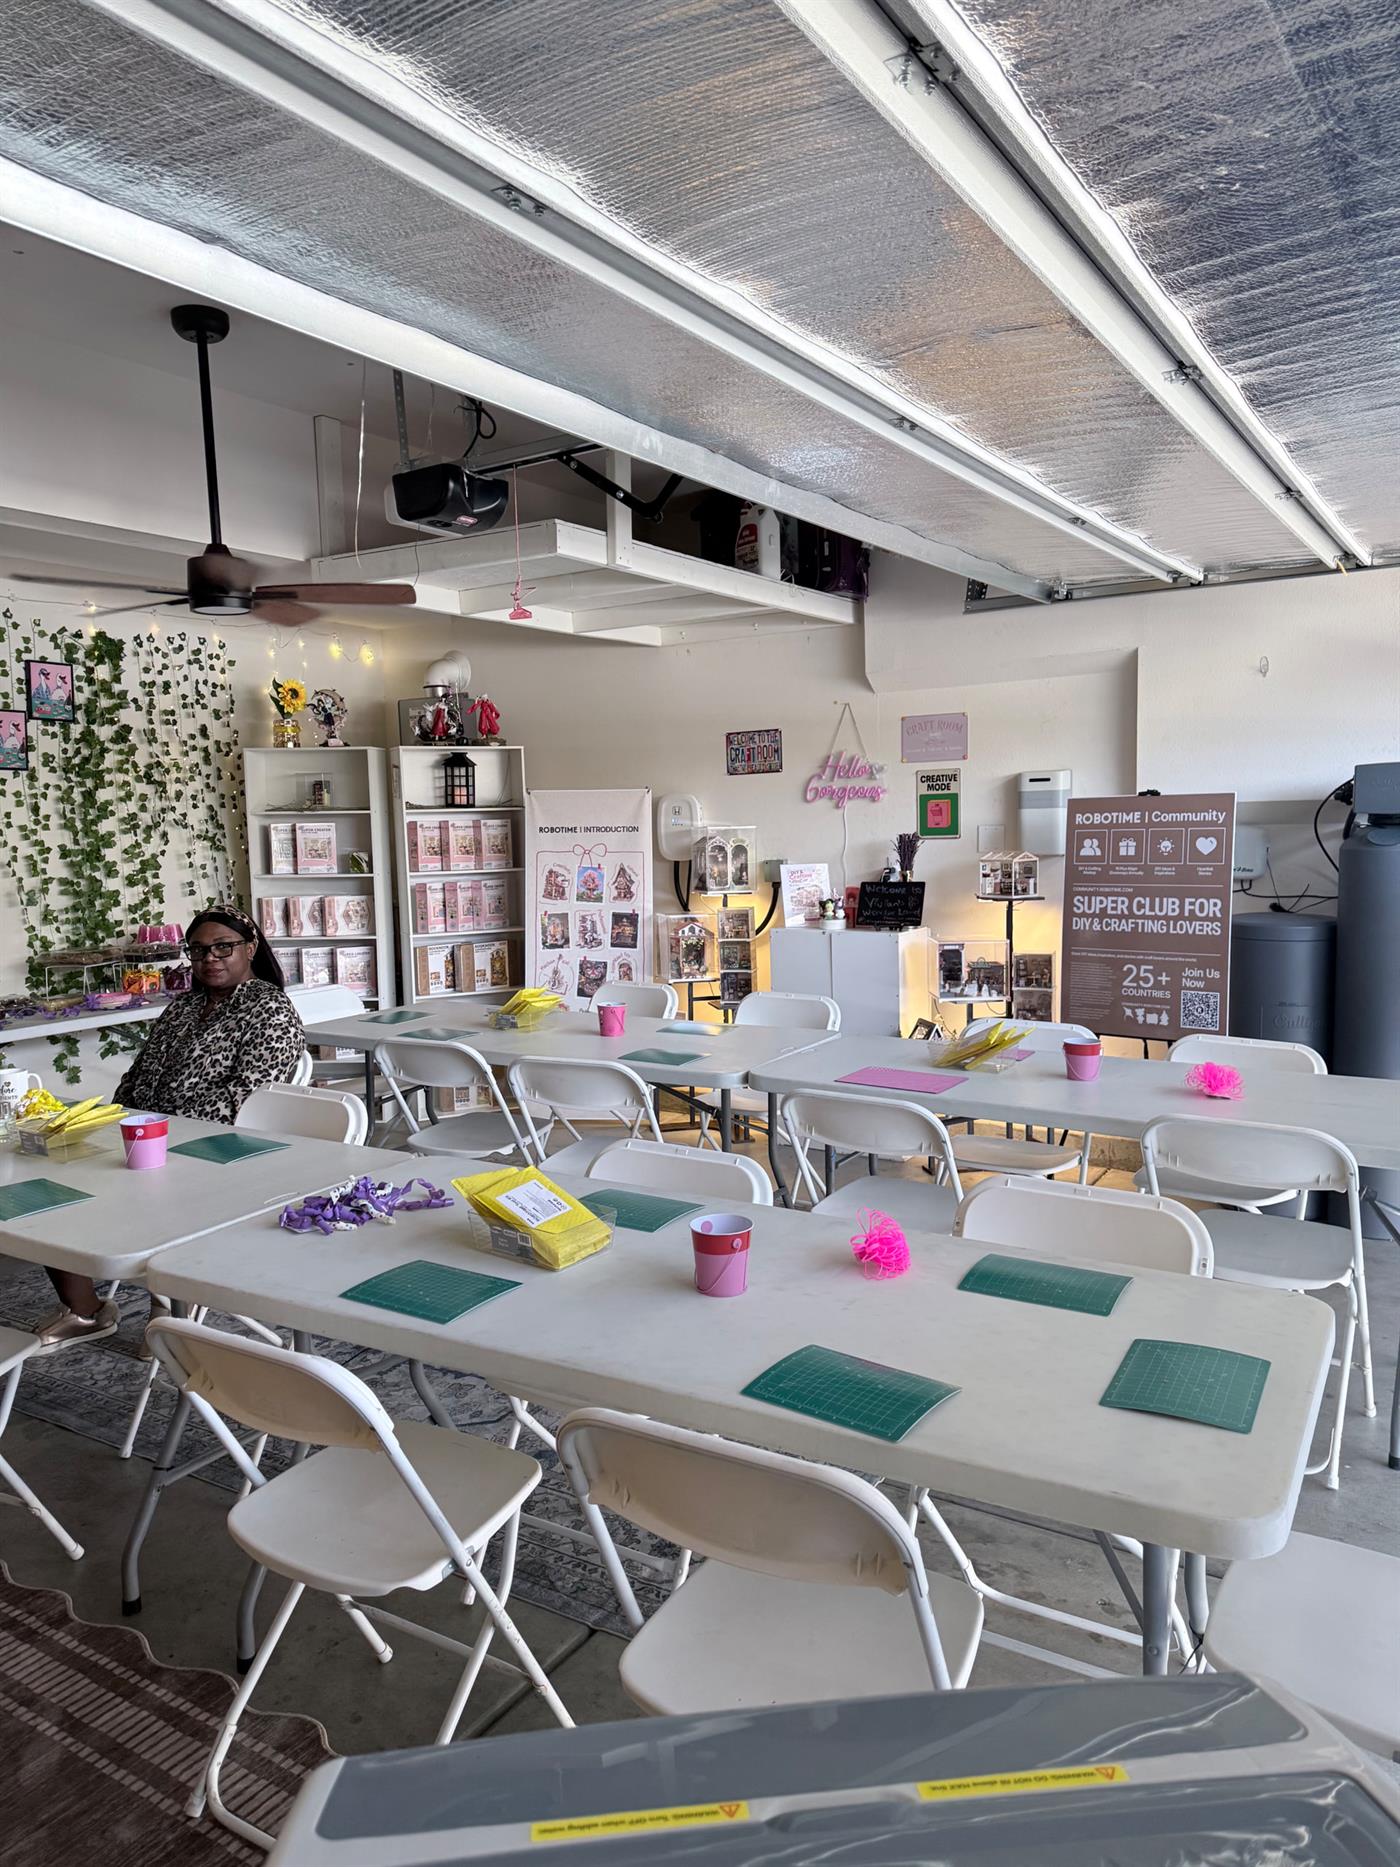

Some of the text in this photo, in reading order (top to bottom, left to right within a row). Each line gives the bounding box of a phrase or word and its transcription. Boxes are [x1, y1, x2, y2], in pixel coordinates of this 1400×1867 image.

[729, 744, 780, 764] CRAFT ROOM
[823, 752, 871, 783] Hello
[920, 773, 958, 784] CREATIVE
[805, 774, 888, 808] Gorgeous
[927, 783, 951, 792] MODE
[1075, 811, 1141, 825] ROBOTIME
[1151, 810, 1226, 824] Community
[538, 826, 578, 834] ROBOTIME
[1073, 896, 1222, 918] SUPER CLUB FOR
[1169, 920, 1221, 936] LOVERS
[1121, 964, 1171, 988] 25+
[1182, 967, 1220, 979] Join Us
[1182, 979, 1205, 988] Now
[1121, 989, 1171, 999] COUNTRIES
